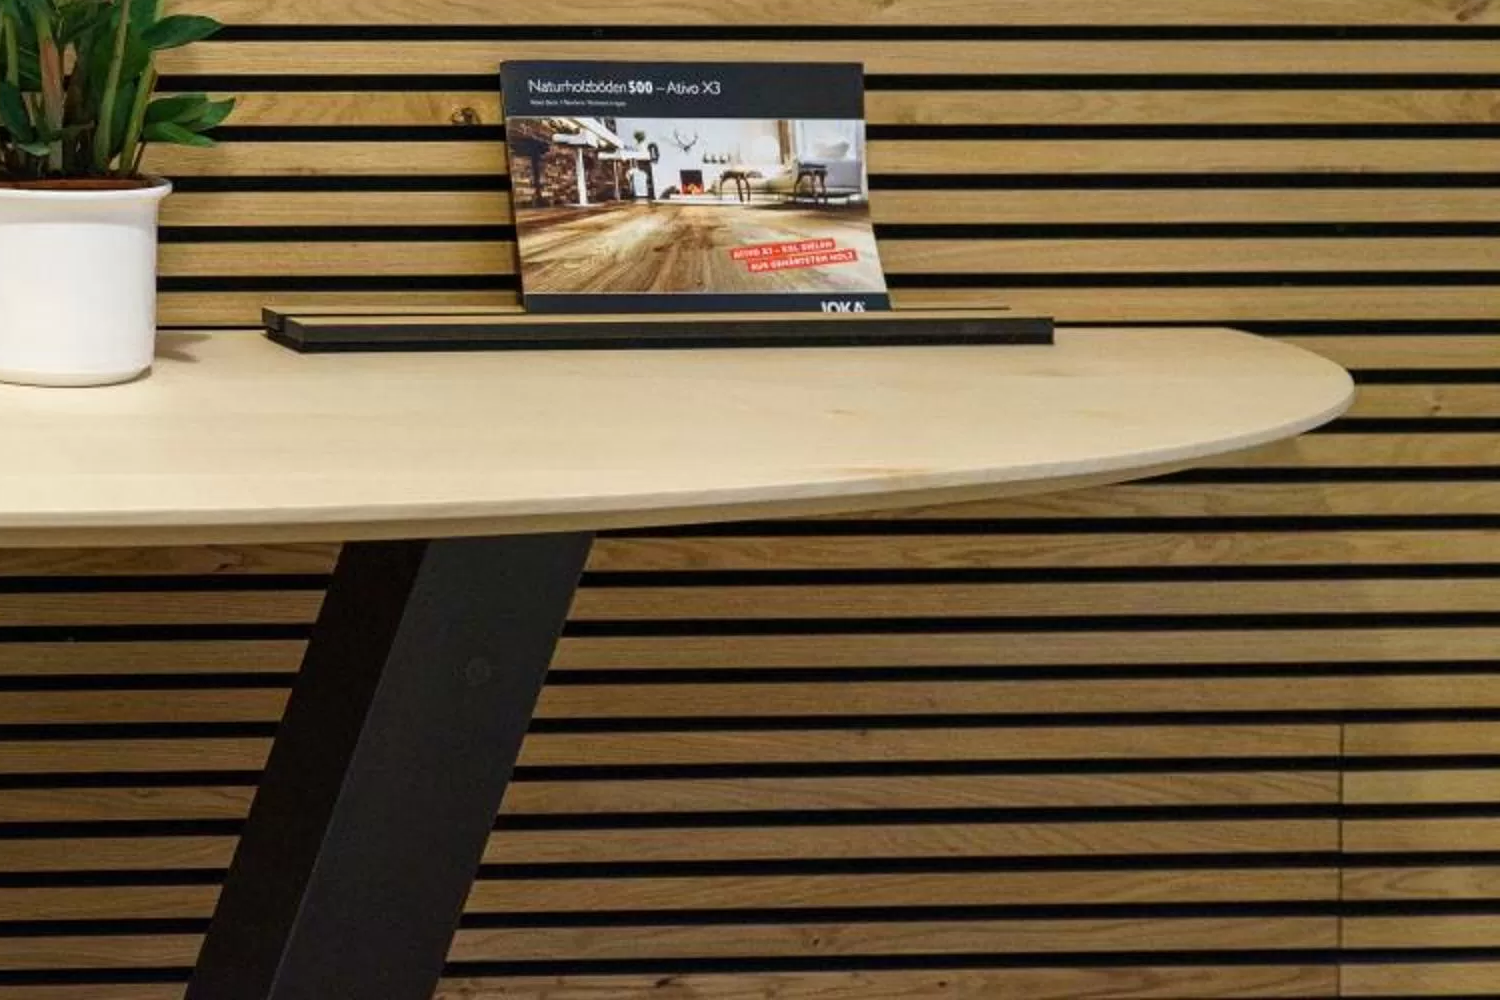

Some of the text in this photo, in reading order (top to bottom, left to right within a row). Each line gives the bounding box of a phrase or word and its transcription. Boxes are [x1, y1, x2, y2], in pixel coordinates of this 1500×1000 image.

[527, 79, 627, 94] Naturholzböden
[628, 80, 653, 94] 500
[666, 80, 699, 95] Ativo
[702, 80, 722, 95] X3
